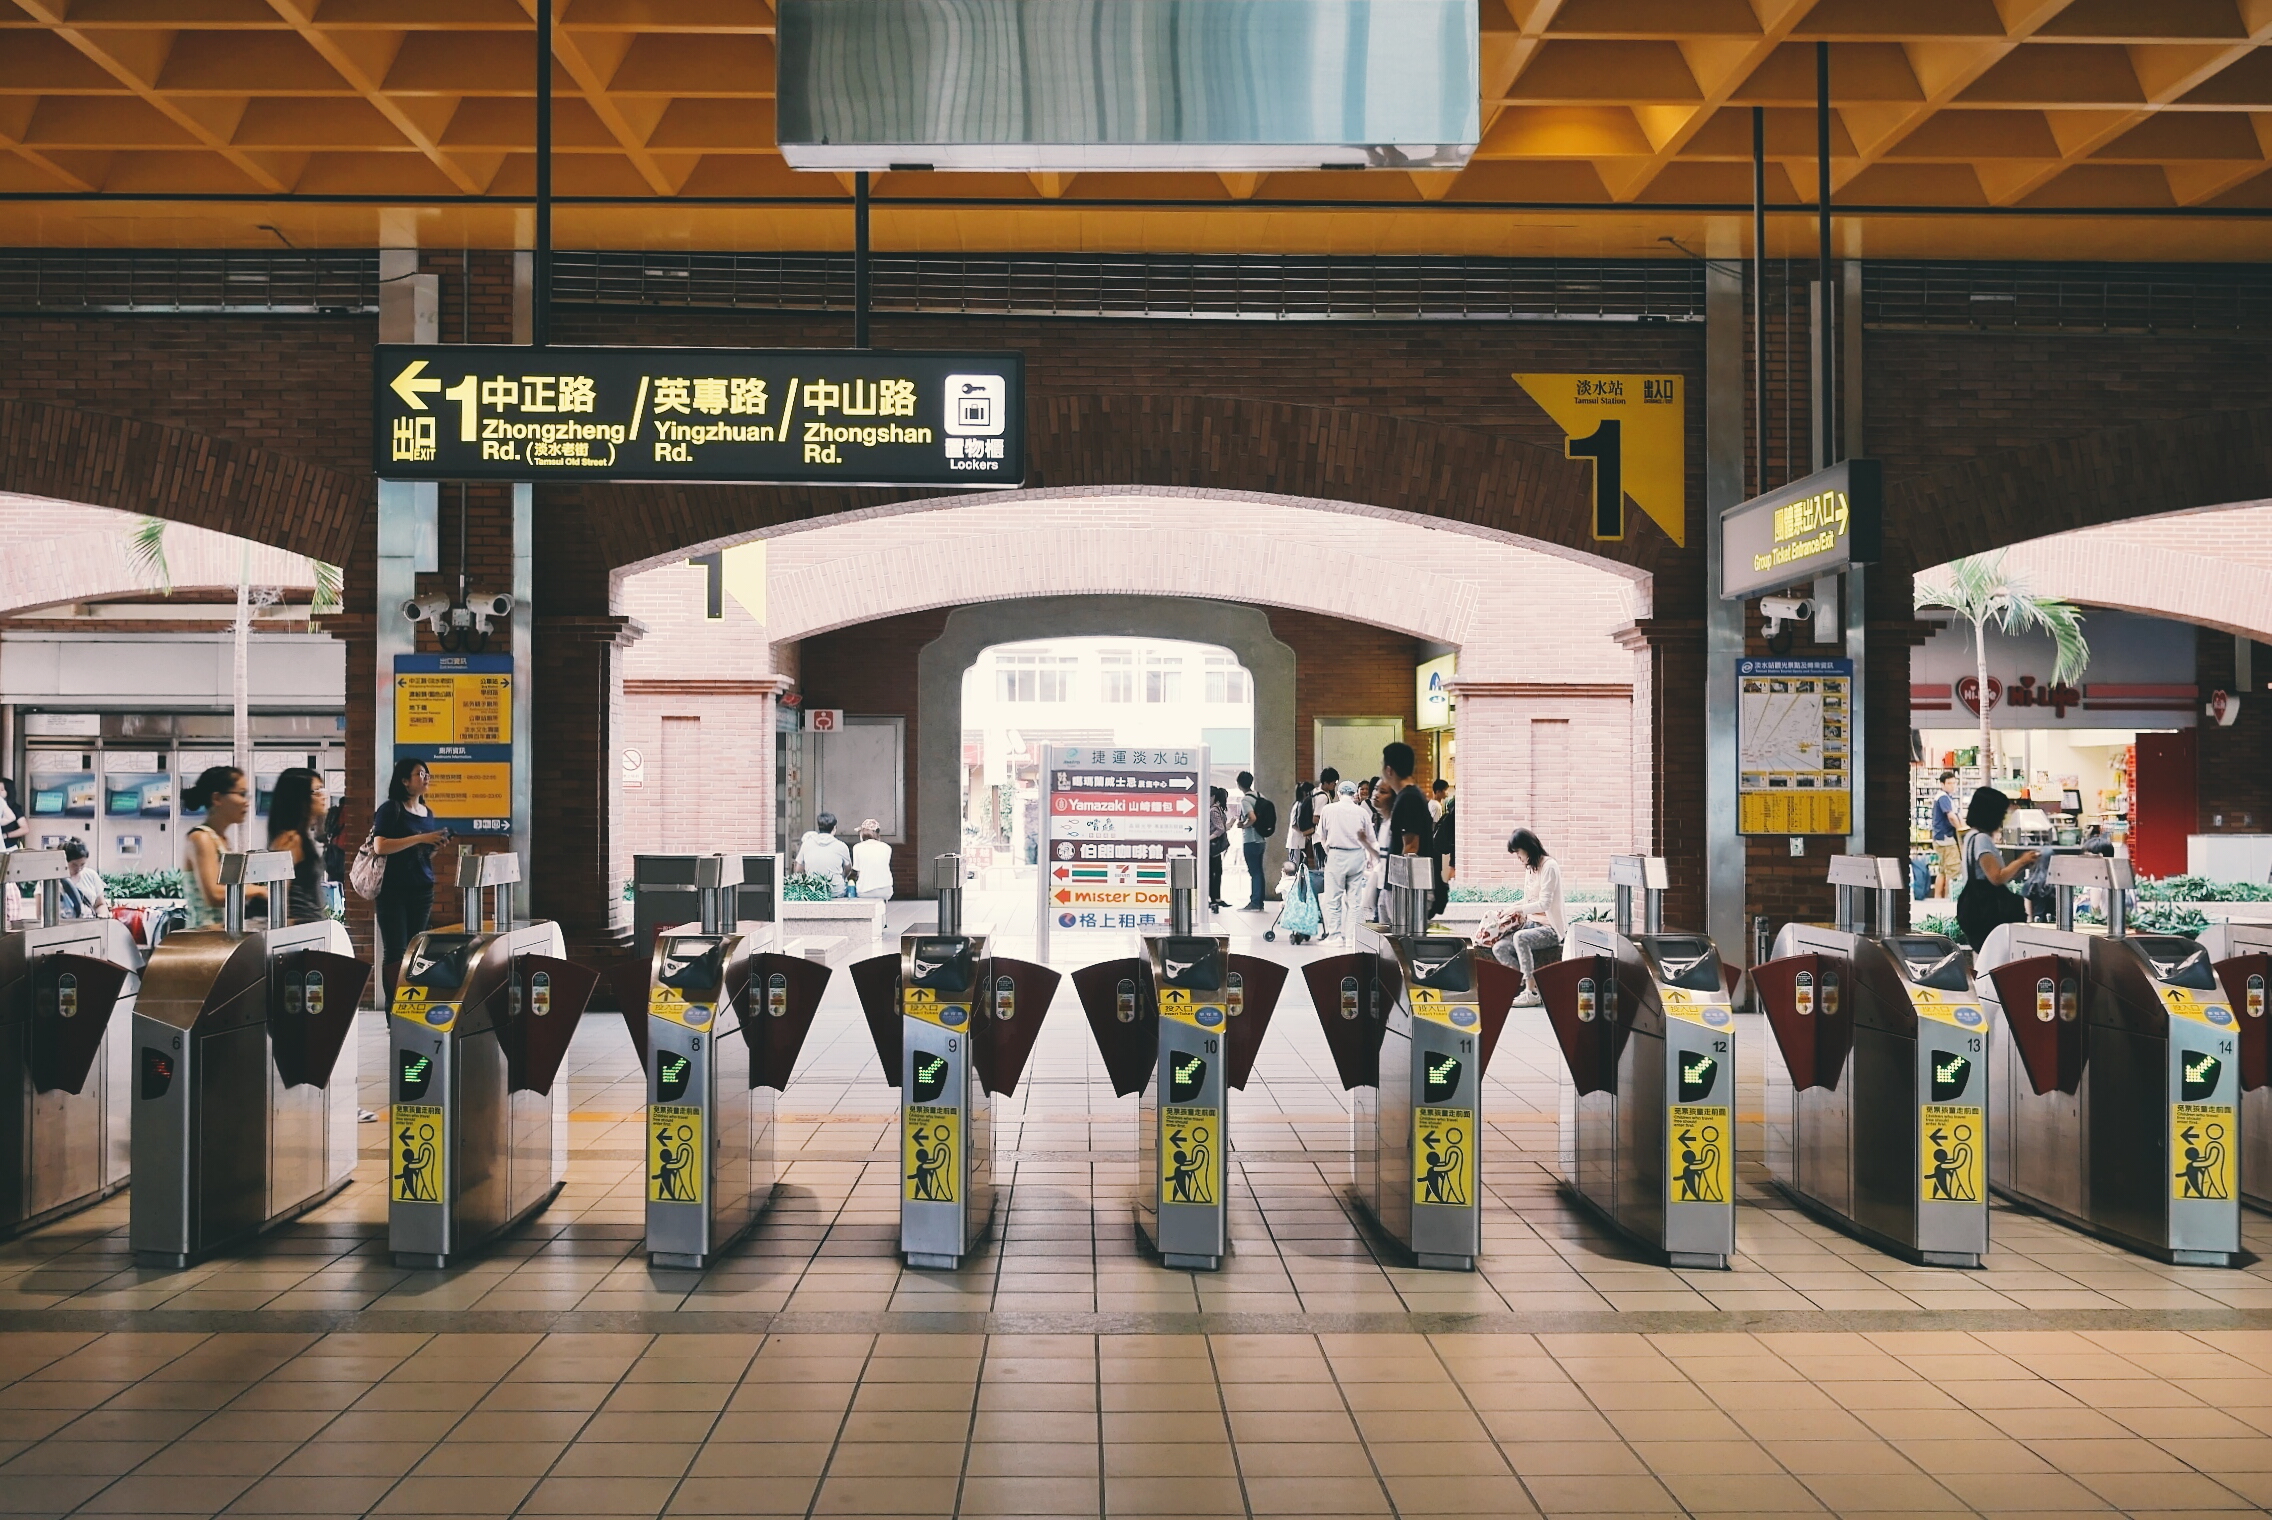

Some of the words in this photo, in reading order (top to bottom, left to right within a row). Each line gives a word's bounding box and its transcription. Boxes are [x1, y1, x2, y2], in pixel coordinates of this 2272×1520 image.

[1576, 379, 1624, 396] 淡水站
[1644, 379, 1673, 399] 出入口
[446, 375, 478, 442] 1
[481, 374, 597, 413] 中正路
[653, 376, 769, 416] 英專路
[803, 378, 917, 418] 中山路
[1574, 397, 1599, 405] Tamsui
[1600, 397, 1626, 405] Station
[482, 418, 625, 444] Zhongzheng
[654, 421, 774, 445] Yingzhuan
[803, 423, 932, 447] Zhongshan
[414, 448, 436, 461] EXIT
[482, 441, 520, 461] Rd.
[654, 442, 693, 462] Rd.
[804, 444, 842, 464] Rd.
[945, 438, 1005, 460] 置物櫃
[534, 457, 563, 466] Tamsui
[565, 457, 580, 466] Old
[581, 457, 608, 466] Street
[950, 459, 999, 471] Lockers
[1569, 419, 1621, 536] 1
[1754, 554, 1773, 571] Group
[1772, 544, 1791, 567] Ticket
[1091, 750, 1188, 765] 捷運淡水站
[1068, 799, 1126, 812] Yamazaki
[1079, 913, 1156, 928] 格上租車
[1165, 1005, 1193, 1013] 投入口
[172, 1036, 181, 1050] 6
[433, 1040, 443, 1055] 7
[691, 1037, 700, 1052] 8
[948, 1038, 957, 1053] 9
[1204, 1040, 1218, 1054] 10
[1460, 1039, 1472, 1054] 11
[1712, 1041, 1727, 1053] 12
[1967, 1038, 1981, 1053] 13
[2218, 1040, 2233, 1055] 14
